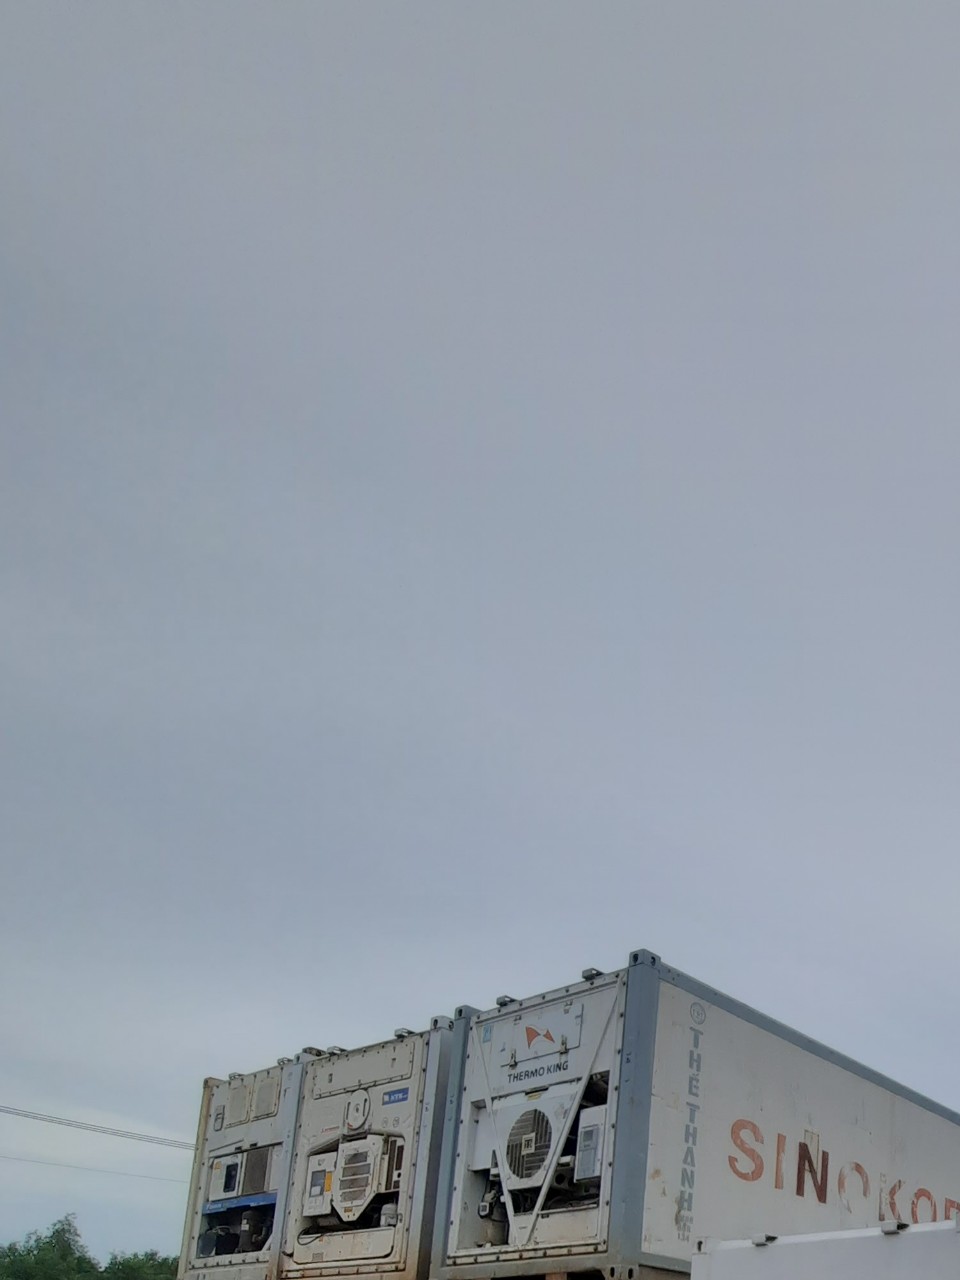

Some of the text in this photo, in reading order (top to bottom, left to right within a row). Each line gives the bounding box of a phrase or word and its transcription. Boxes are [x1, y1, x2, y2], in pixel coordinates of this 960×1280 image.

[507, 1060, 569, 1083] THERMO KING
[679, 1101, 701, 1212] THANH
